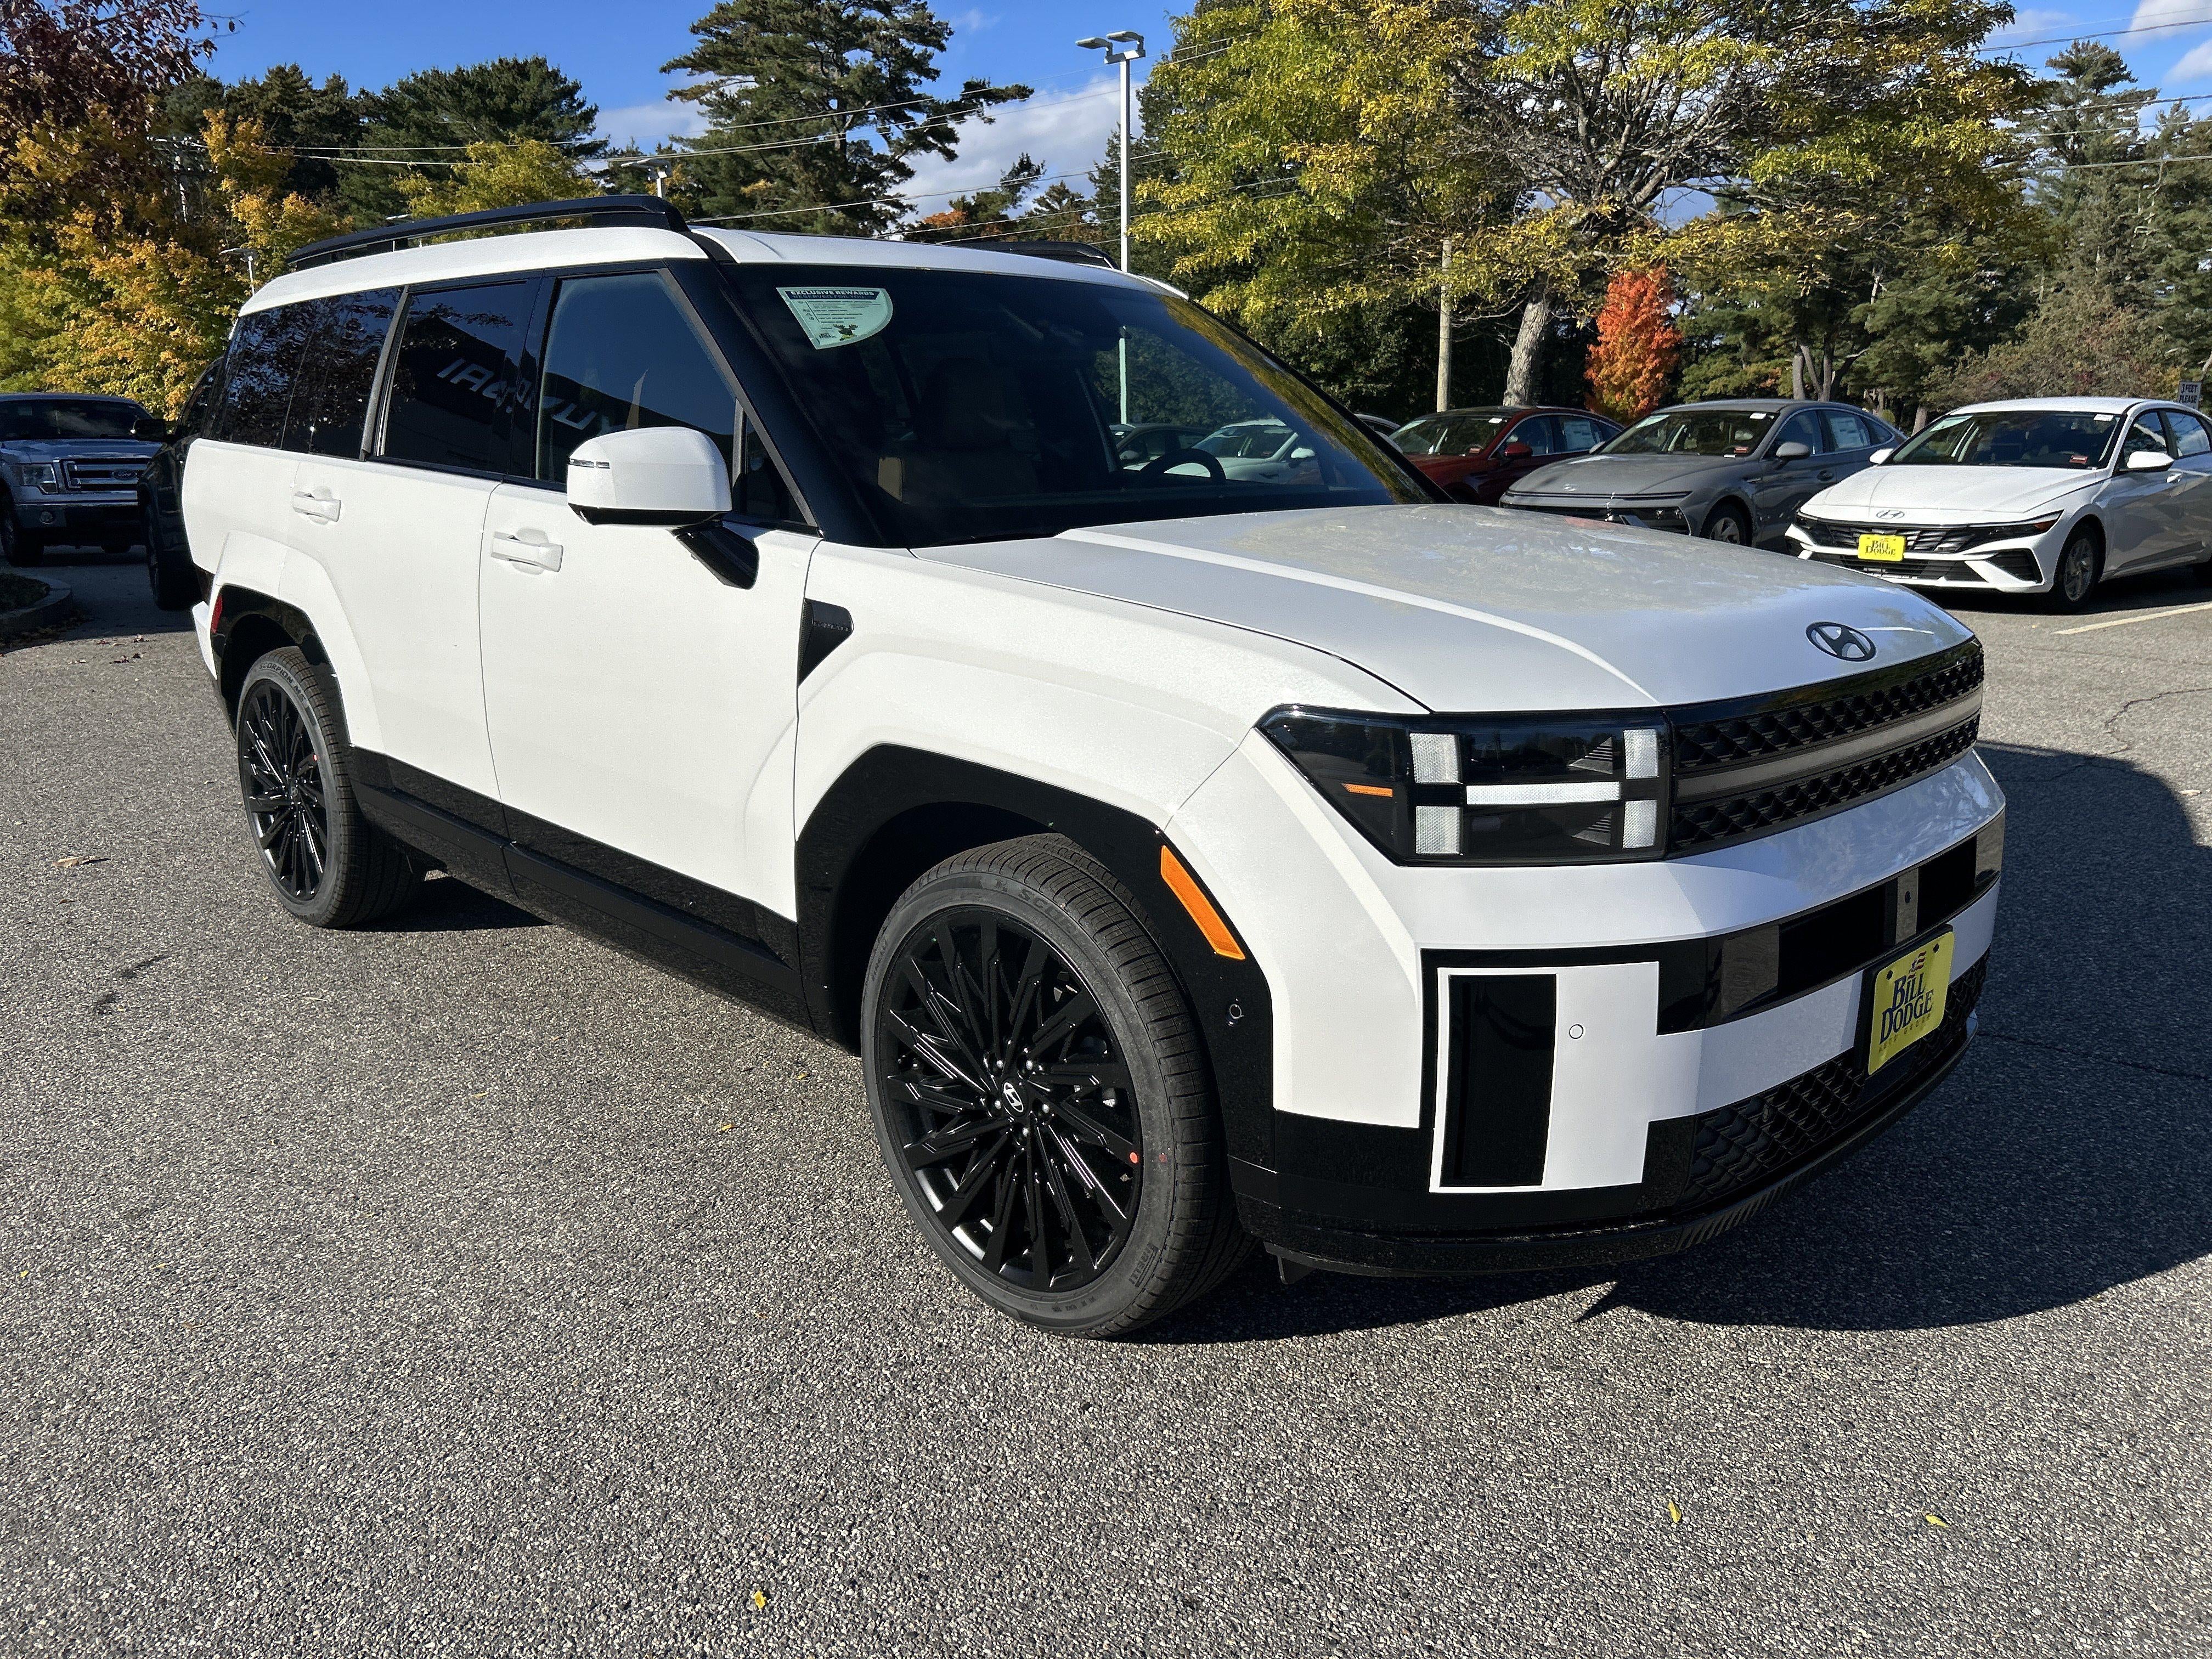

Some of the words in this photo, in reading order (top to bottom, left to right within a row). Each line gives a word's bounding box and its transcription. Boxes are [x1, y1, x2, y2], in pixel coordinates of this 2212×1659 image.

[2185, 384, 2198, 393] FEET
[1865, 545, 1897, 556] DODGE
[1872, 540, 1891, 549] BILL
[258, 662, 294, 684] SCORPION
[1892, 972, 1927, 1012] BILL
[1879, 989, 1934, 1045] DODGE
[1127, 1242, 1159, 1287] PIRELLI
